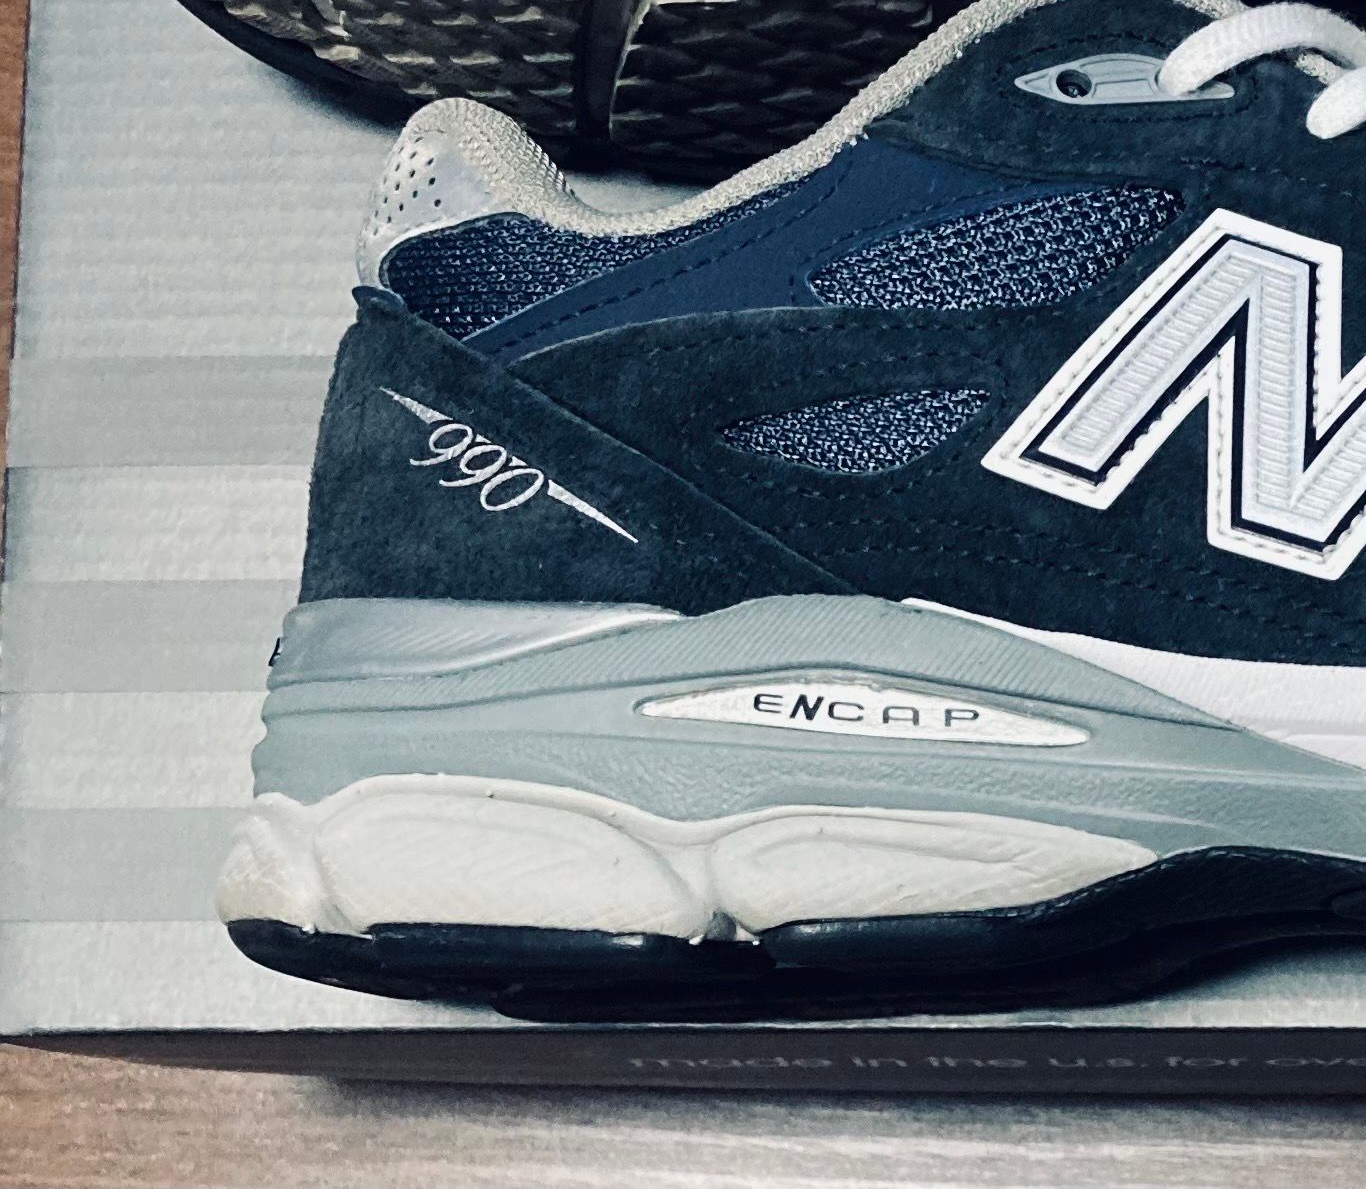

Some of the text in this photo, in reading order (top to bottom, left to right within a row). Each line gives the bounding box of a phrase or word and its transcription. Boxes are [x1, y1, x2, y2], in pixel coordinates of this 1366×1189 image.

[409, 422, 544, 511] 990
[753, 693, 979, 727] ENCAP
[628, 1056, 833, 1069] made
[850, 1055, 909, 1068] in
[924, 1055, 1028, 1068] the
[1164, 1055, 1249, 1068] for
